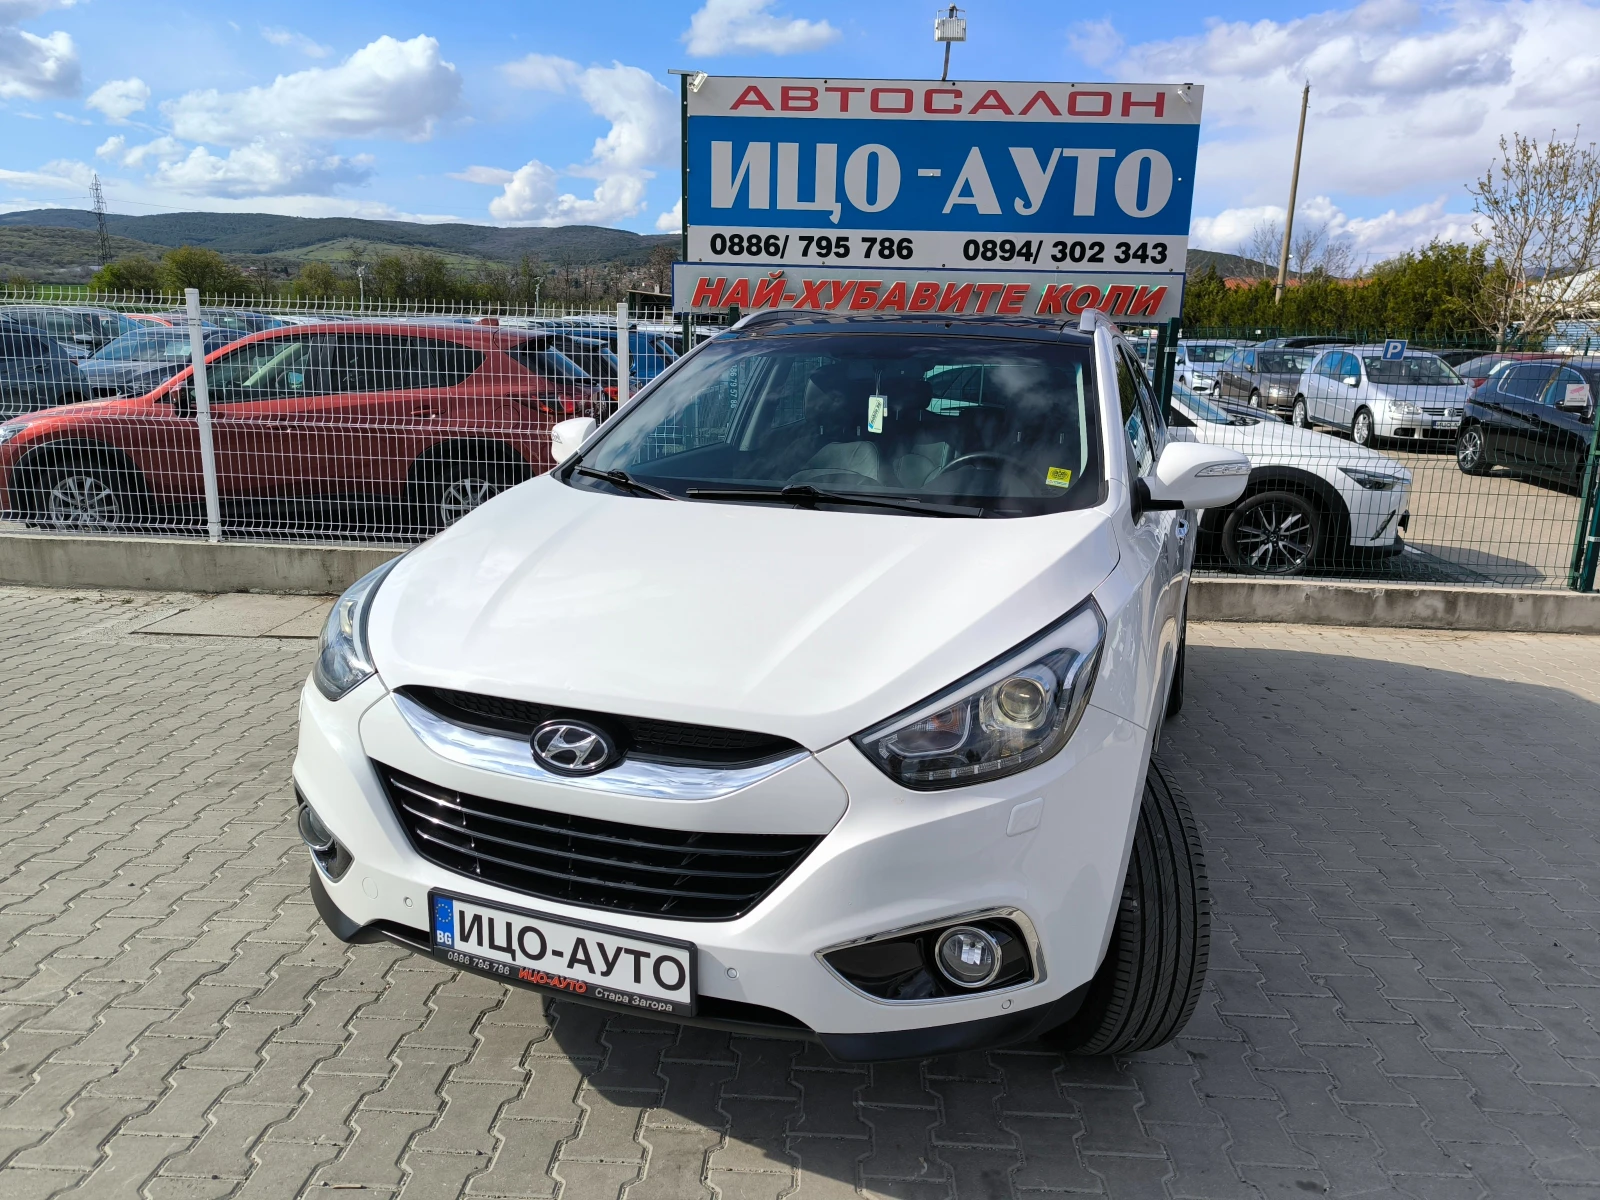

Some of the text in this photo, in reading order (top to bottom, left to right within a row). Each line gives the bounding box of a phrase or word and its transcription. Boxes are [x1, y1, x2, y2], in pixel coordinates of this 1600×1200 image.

[729, 85, 1166, 118] АВТОСАЛОН
[709, 233, 914, 260] 0886/ 795 786
[962, 238, 1168, 265] 0894/ 302 343
[691, 270, 1169, 317] НАЙ-ХУБАВИТЕ КОЛИ
[1386, 342, 1402, 358] P
[436, 930, 452, 945] BG
[458, 909, 687, 992] ИЦО-АУТО
[447, 951, 510, 975] 0886 795 786
[518, 967, 587, 994] ИЦО-АУТО
[595, 987, 673, 1012] Стара Загора
